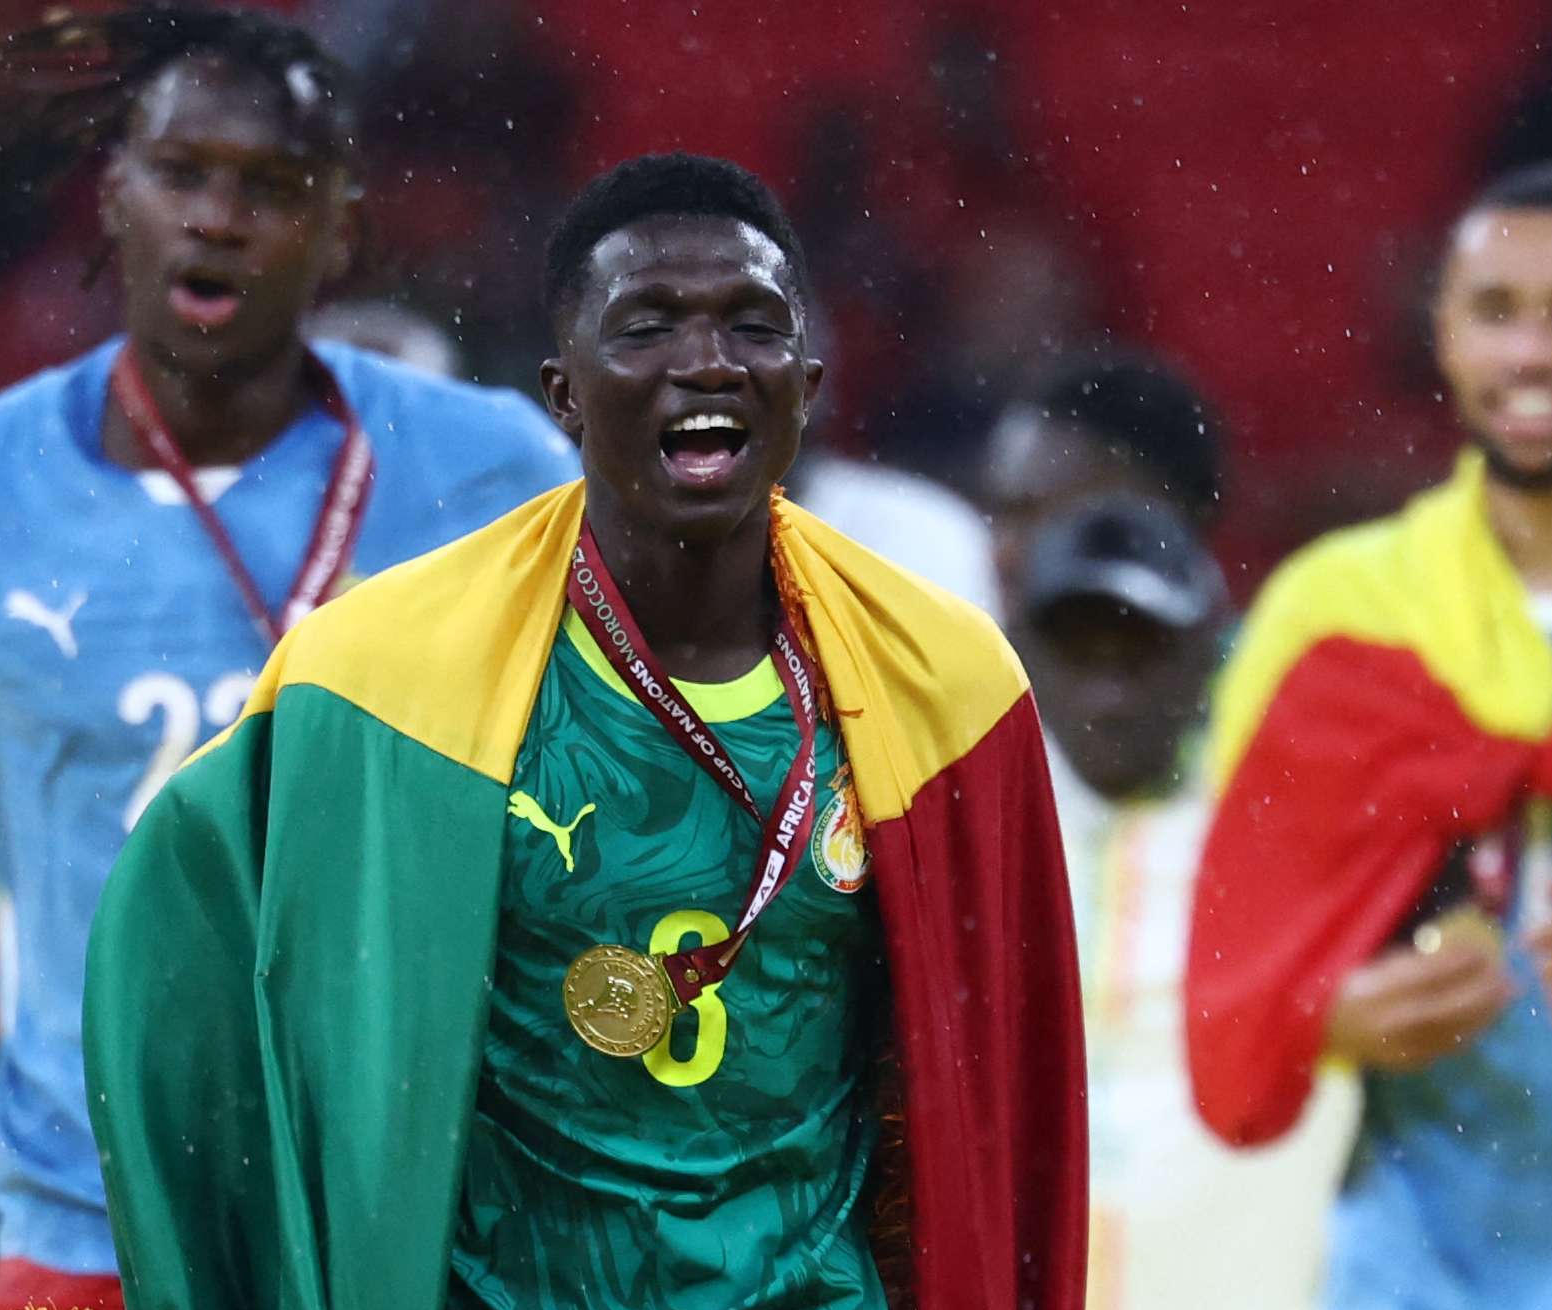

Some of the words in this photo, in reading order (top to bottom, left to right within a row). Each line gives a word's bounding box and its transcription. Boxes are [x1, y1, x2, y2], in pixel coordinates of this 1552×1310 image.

[576, 567, 638, 664] MOROCCO
[629, 659, 696, 733] NATIONS
[774, 631, 813, 714] NATIONS
[690, 733, 716, 756] OF
[749, 865, 776, 918] CAF
[775, 779, 814, 850] AFRICA
[641, 909, 731, 1088] 8
